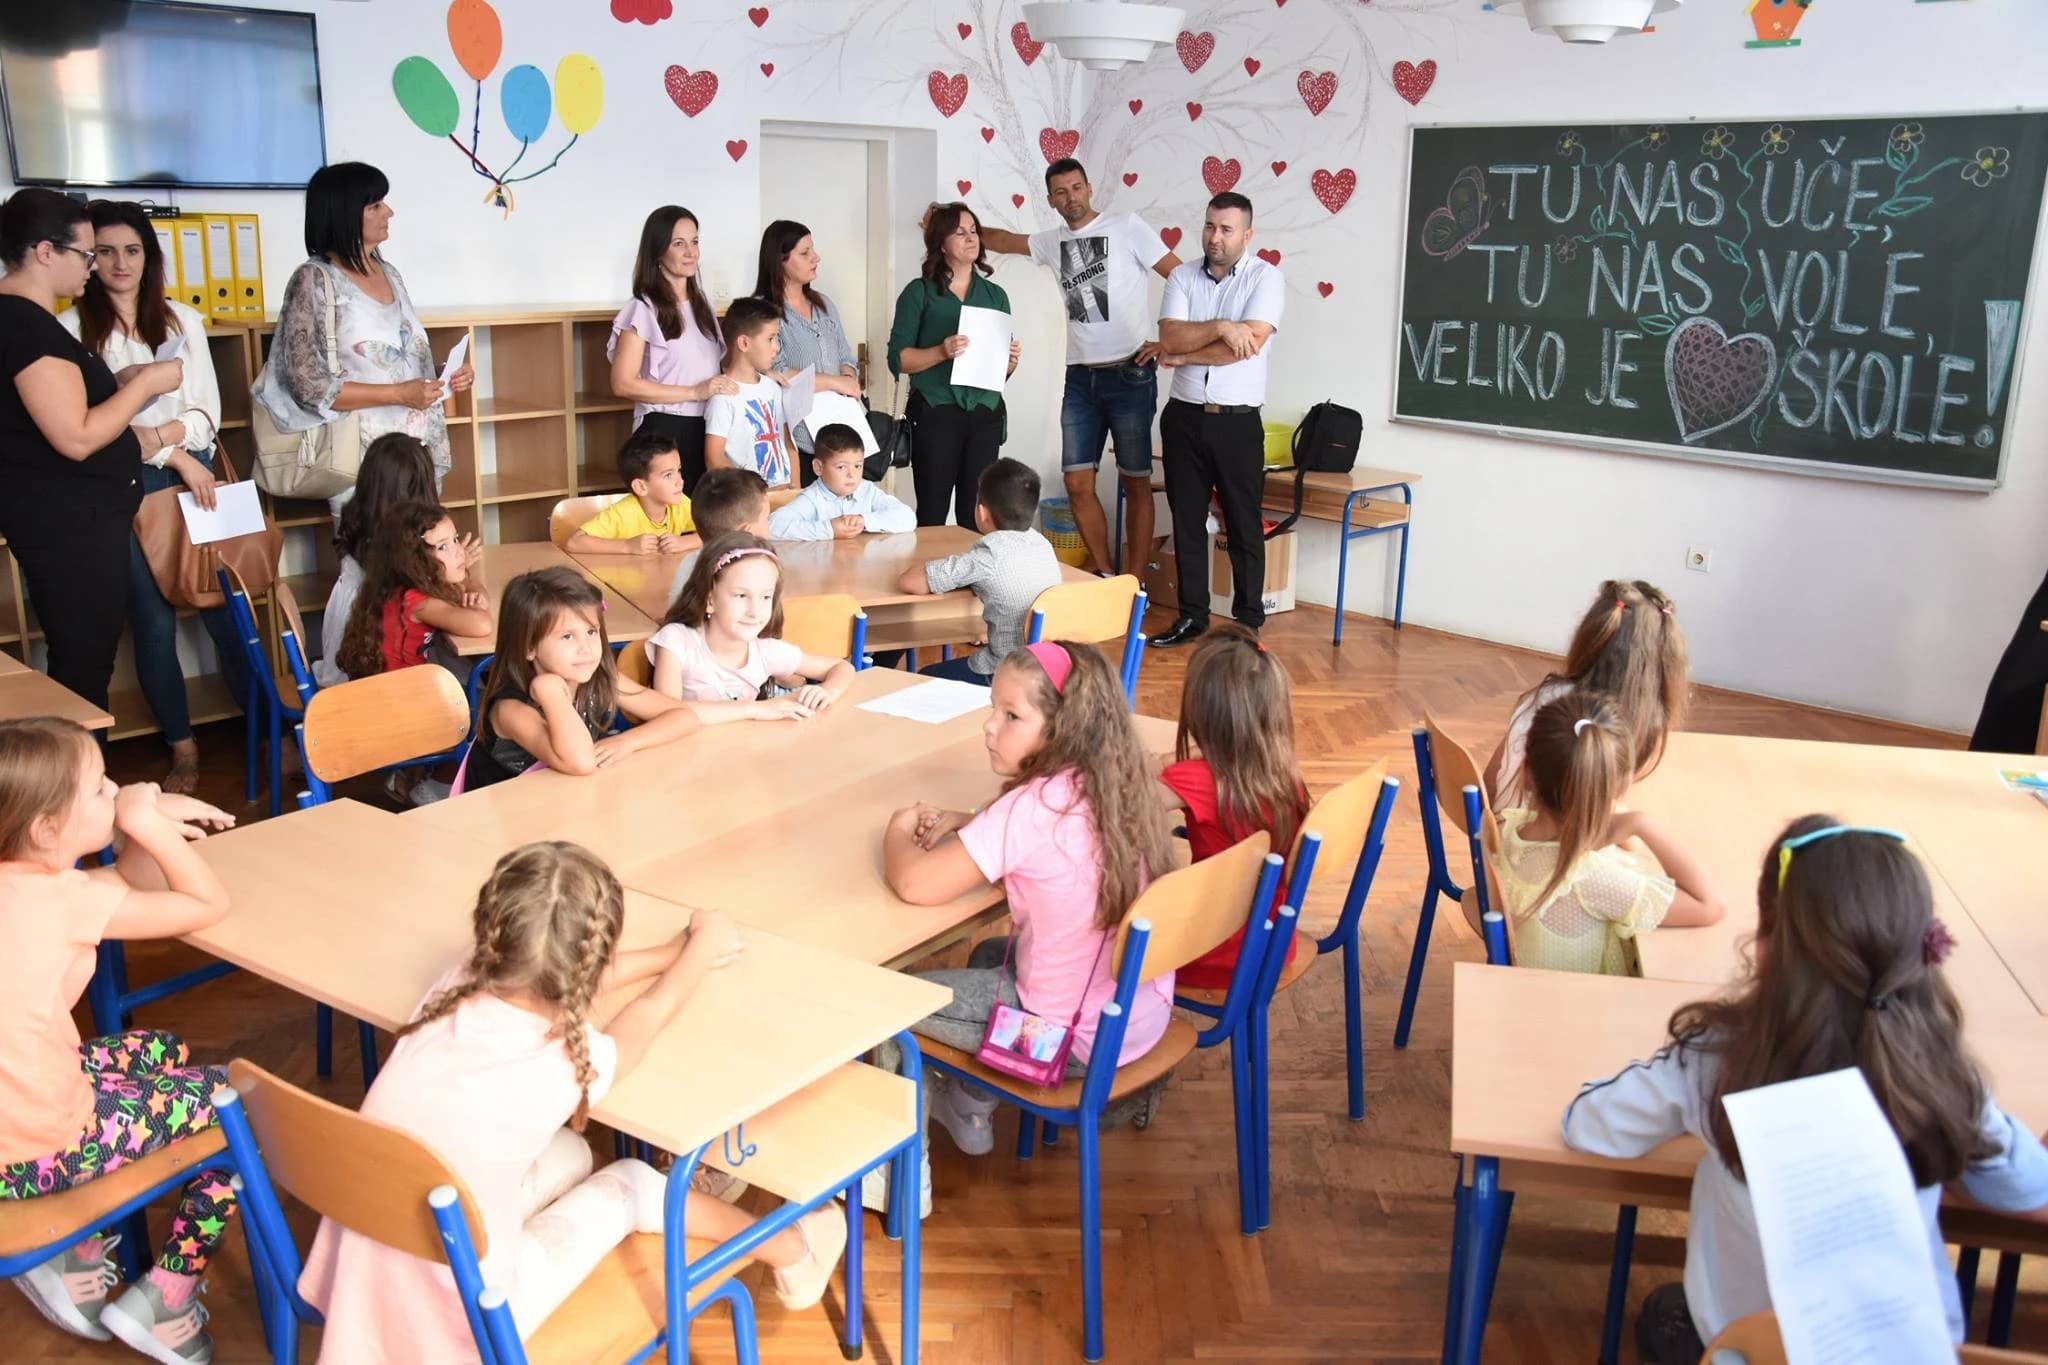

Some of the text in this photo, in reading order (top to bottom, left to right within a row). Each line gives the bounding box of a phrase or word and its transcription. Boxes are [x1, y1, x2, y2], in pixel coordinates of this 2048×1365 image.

[1488, 164, 1580, 223] TU
[1609, 160, 1726, 226] NAS
[1072, 262, 1105, 287] STRONG
[1467, 244, 1551, 308] TU
[1587, 241, 1713, 318] NAS
[1403, 320, 1643, 409] VELIKO JE
